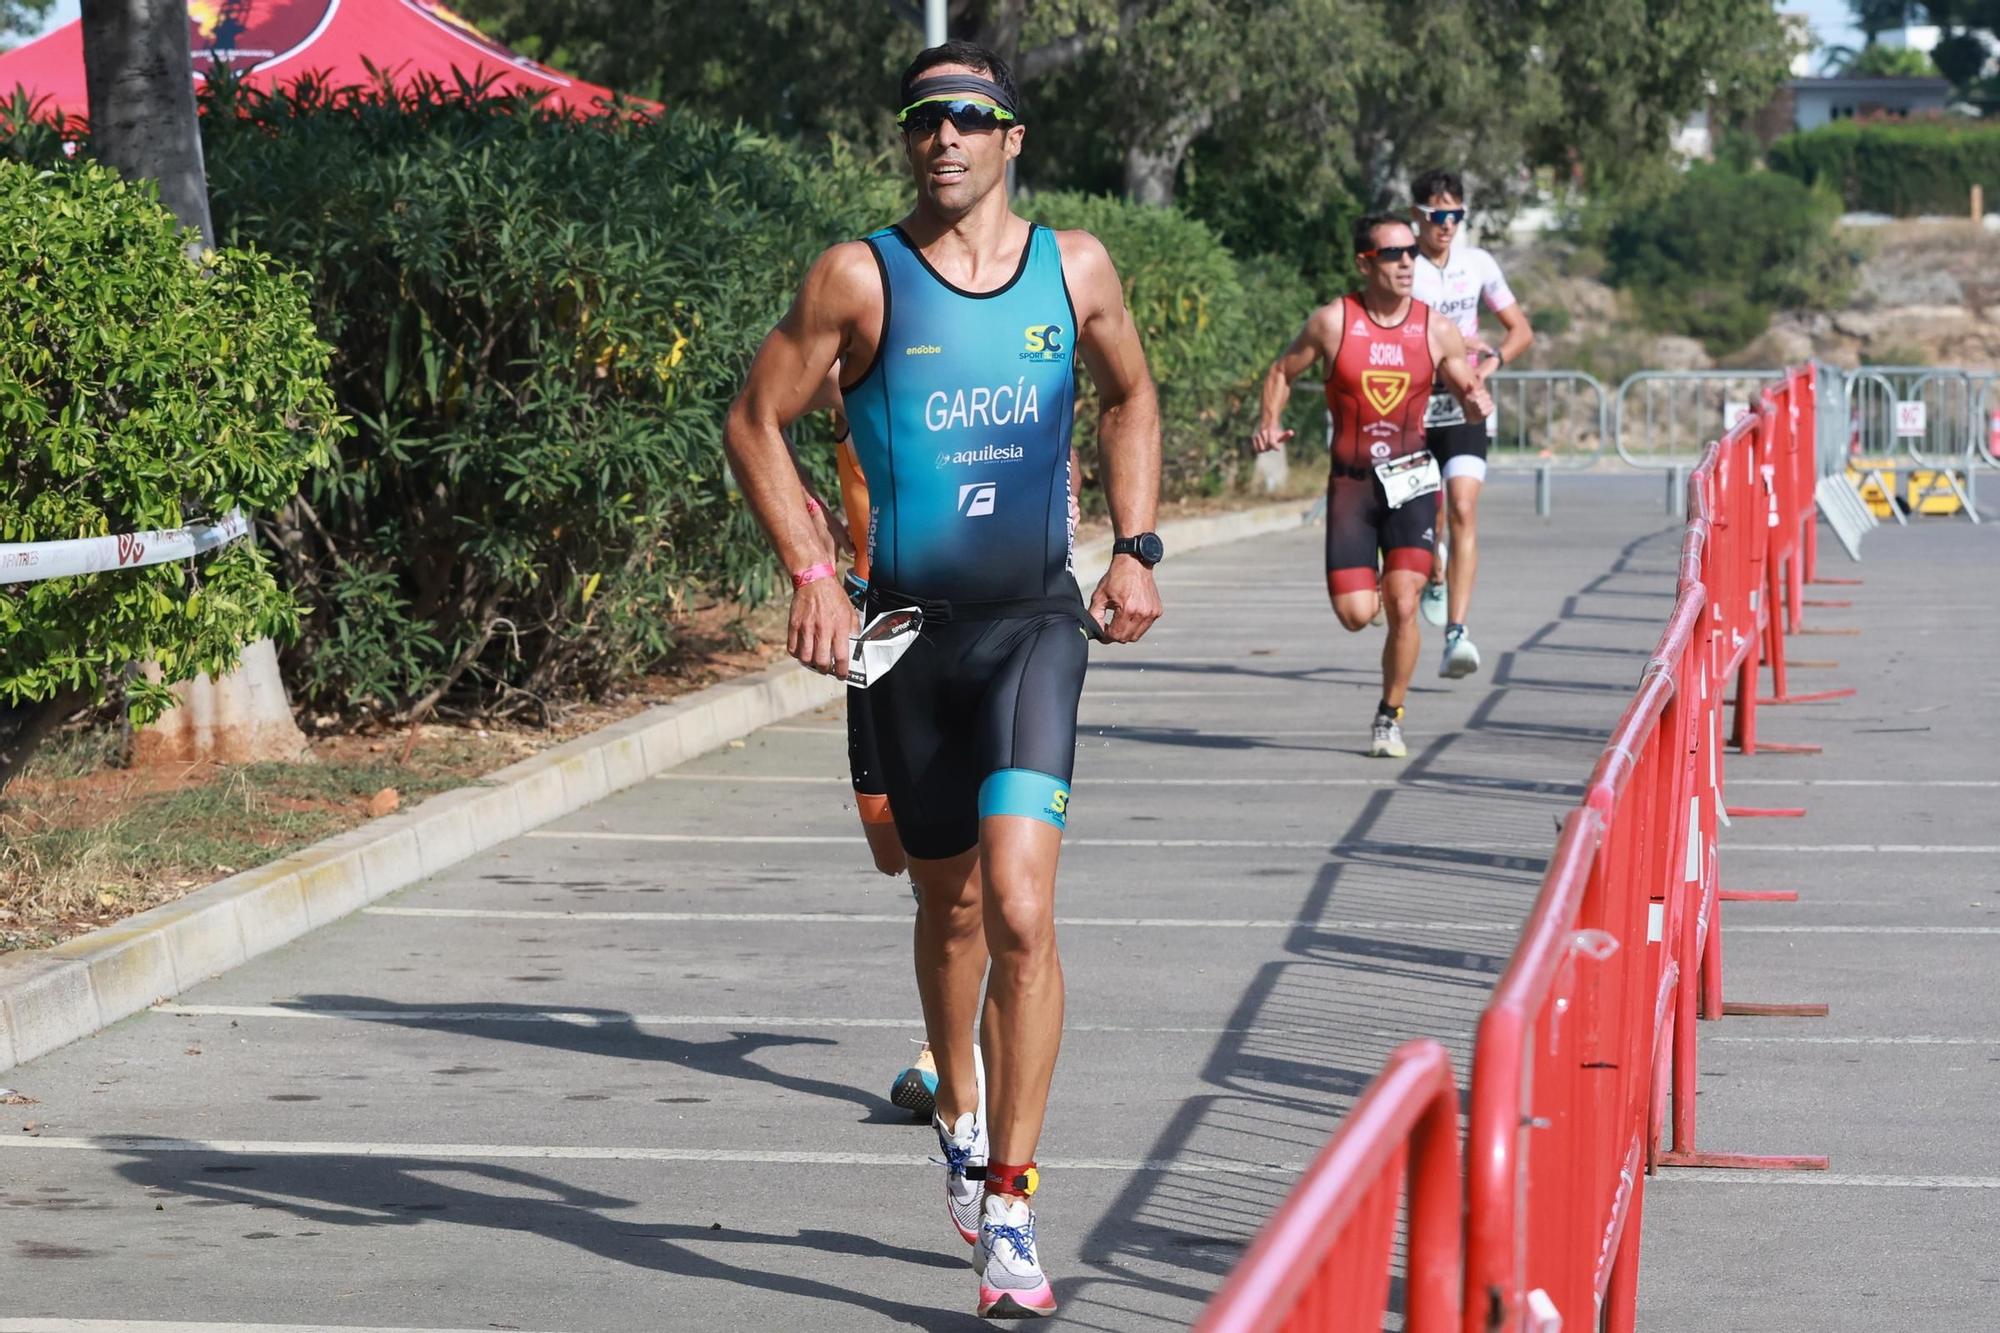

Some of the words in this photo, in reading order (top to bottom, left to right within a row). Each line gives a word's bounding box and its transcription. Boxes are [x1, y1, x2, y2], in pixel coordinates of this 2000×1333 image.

[1024, 325, 1063, 352] SC
[1369, 342, 1404, 366] SORIA
[925, 376, 1039, 431] GARCÍA
[953, 444, 1023, 466] aquilesia
